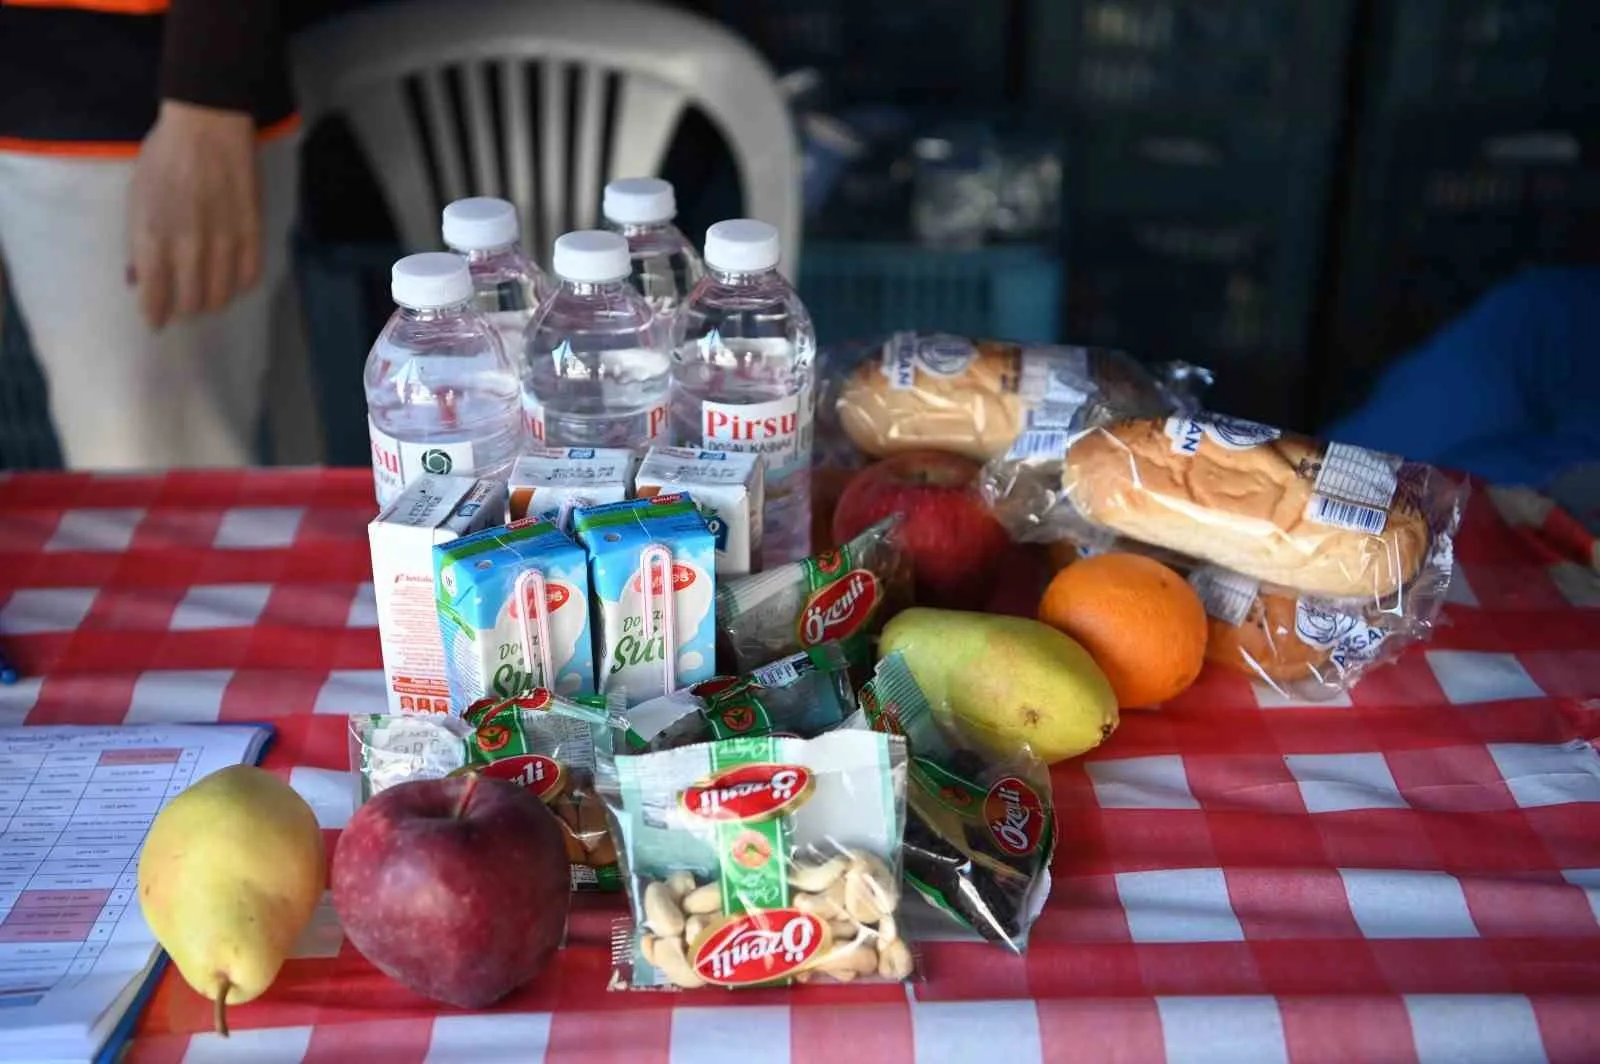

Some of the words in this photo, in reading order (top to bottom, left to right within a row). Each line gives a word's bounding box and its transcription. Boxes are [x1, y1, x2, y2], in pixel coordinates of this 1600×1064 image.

[707, 409, 797, 441] Pirsu
[806, 575, 865, 644] Özenli
[711, 916, 815, 978] Özenli
